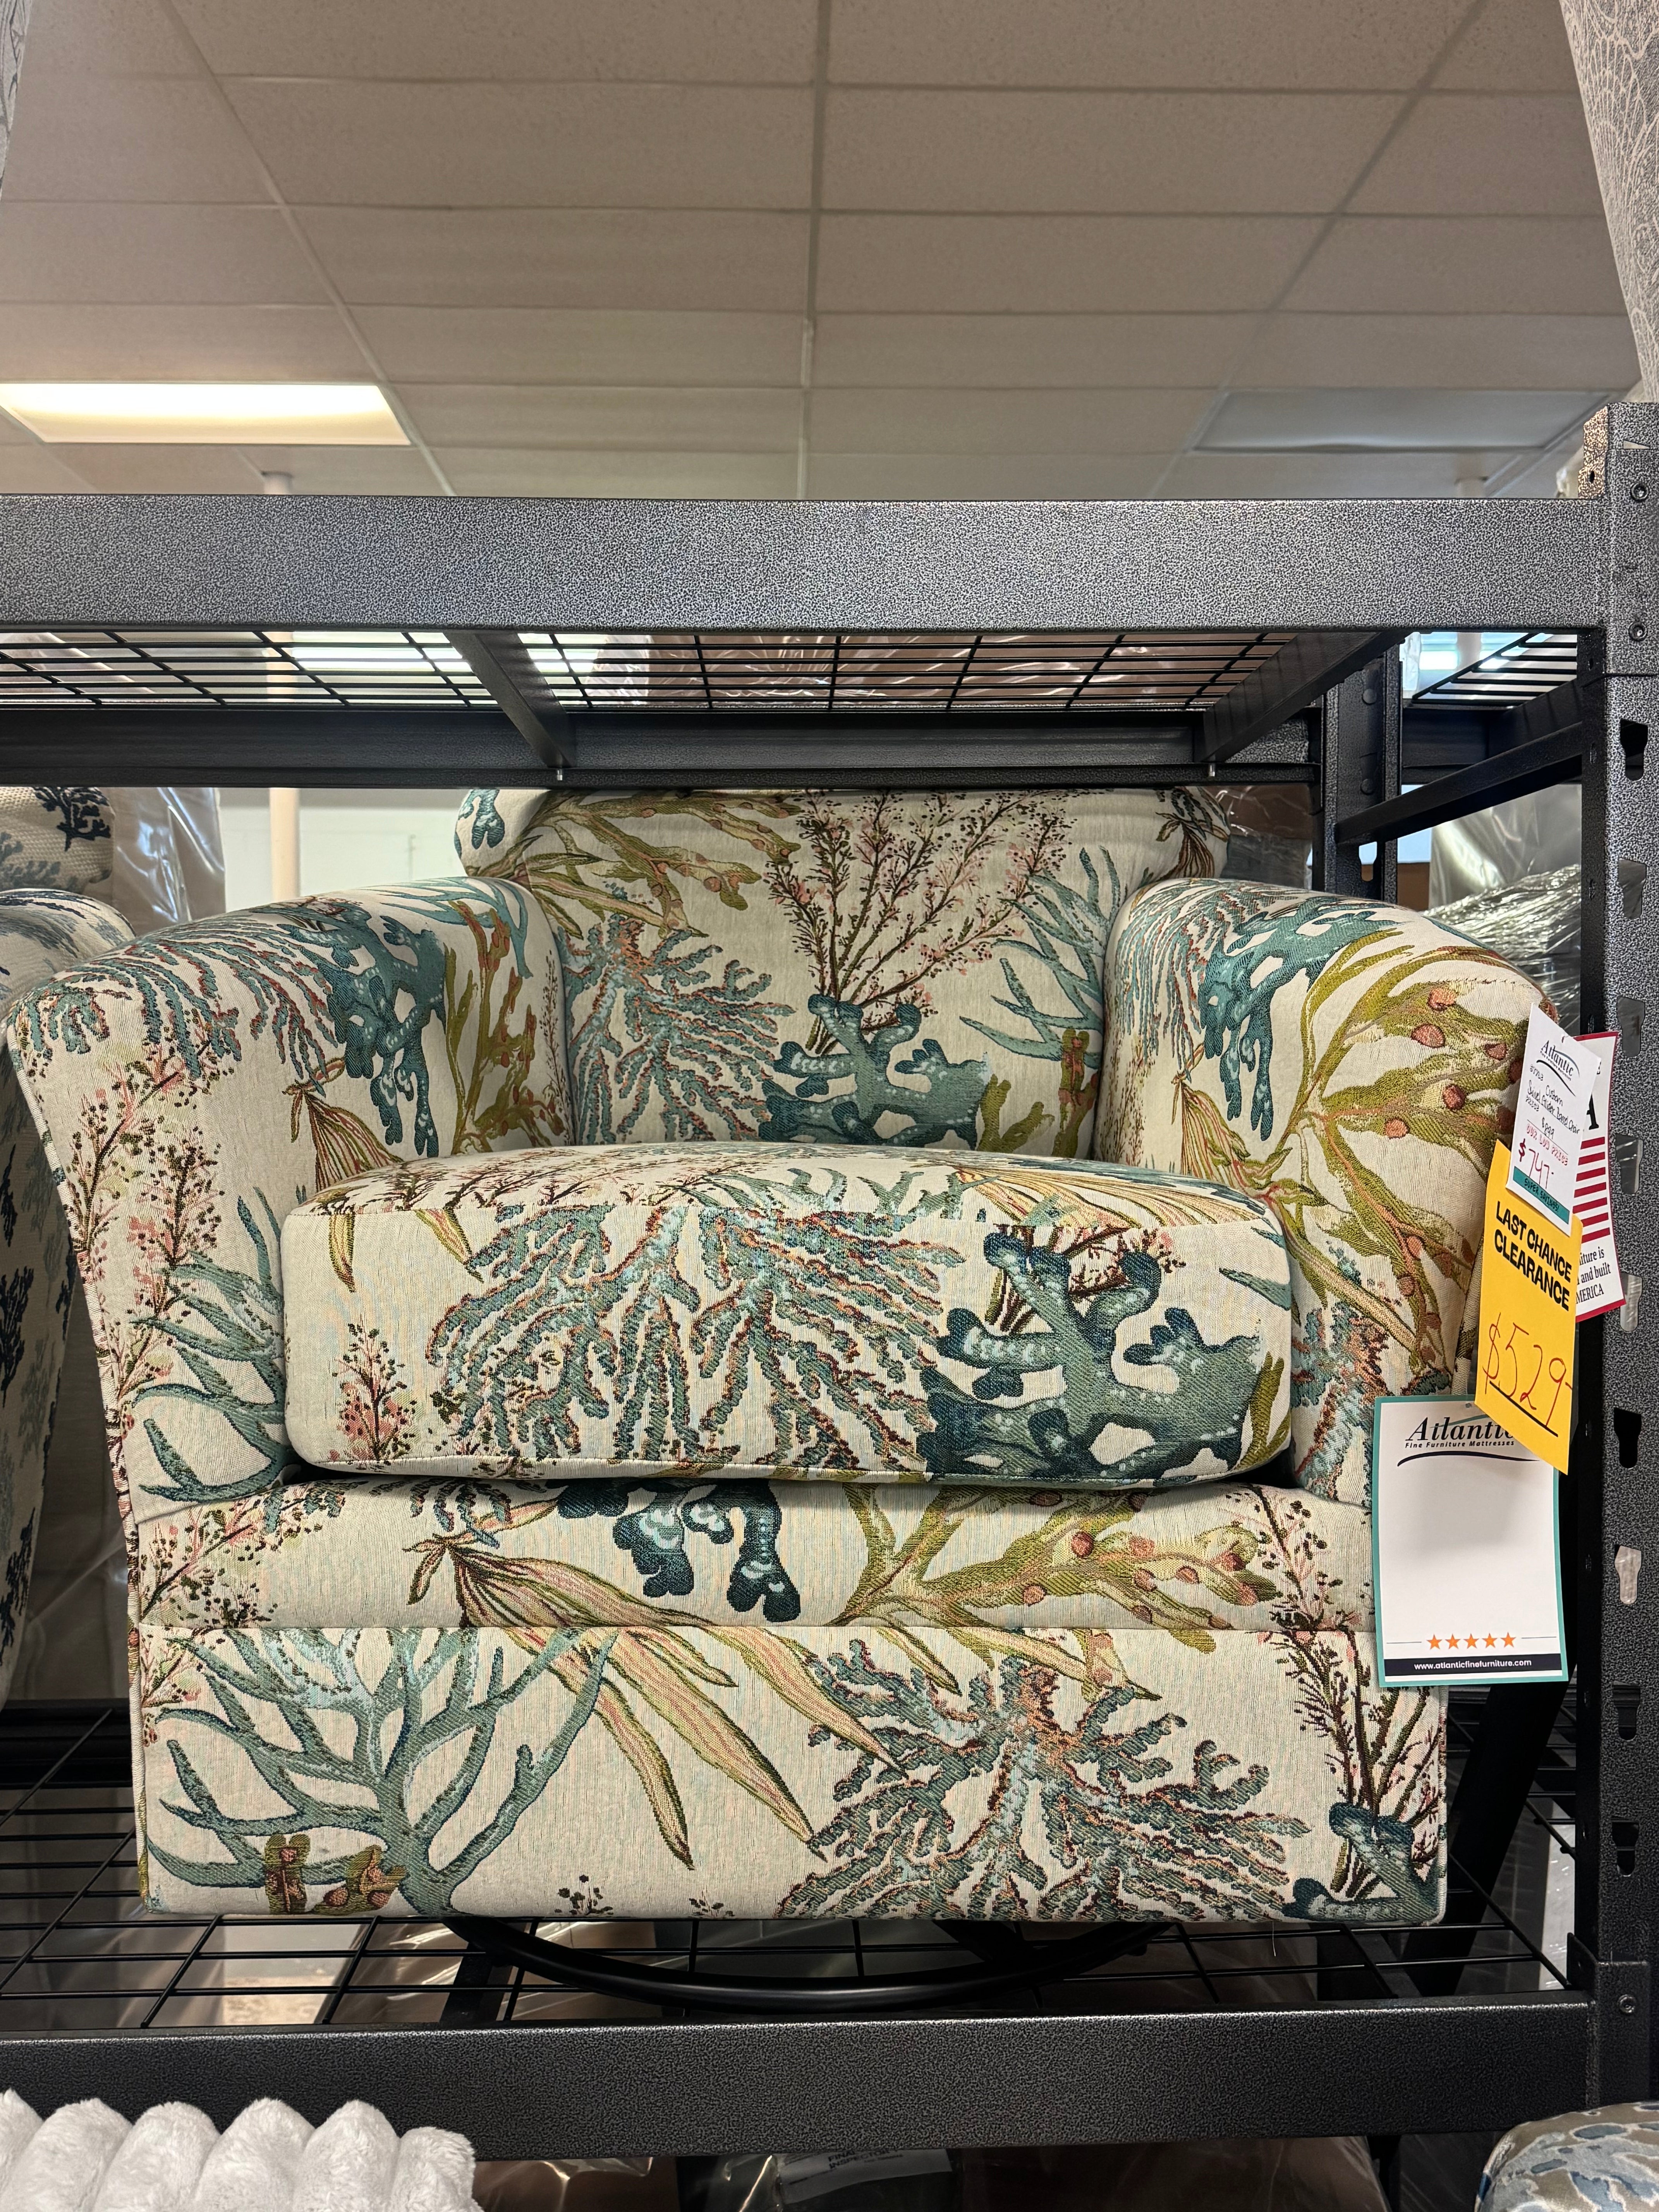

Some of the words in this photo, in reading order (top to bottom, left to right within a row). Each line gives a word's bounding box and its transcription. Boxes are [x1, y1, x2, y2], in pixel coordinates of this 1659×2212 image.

[1541, 1040, 1573, 1076] Atlantic
[1496, 1200, 1527, 1241] LAST
[1527, 1228, 1572, 1283] CHANCE
[1579, 1252, 1597, 1266] iture
[1598, 1246, 1604, 1259] is
[1494, 1229, 1570, 1312] CLEARANCE
[1581, 1267, 1594, 1283] and
[1594, 1262, 1611, 1278] built
[1576, 1283, 1604, 1304] MERICA
[1413, 1659, 1532, 1670] www.atlanticfinefurniture.com
[828, 2150, 855, 2162] FINA
